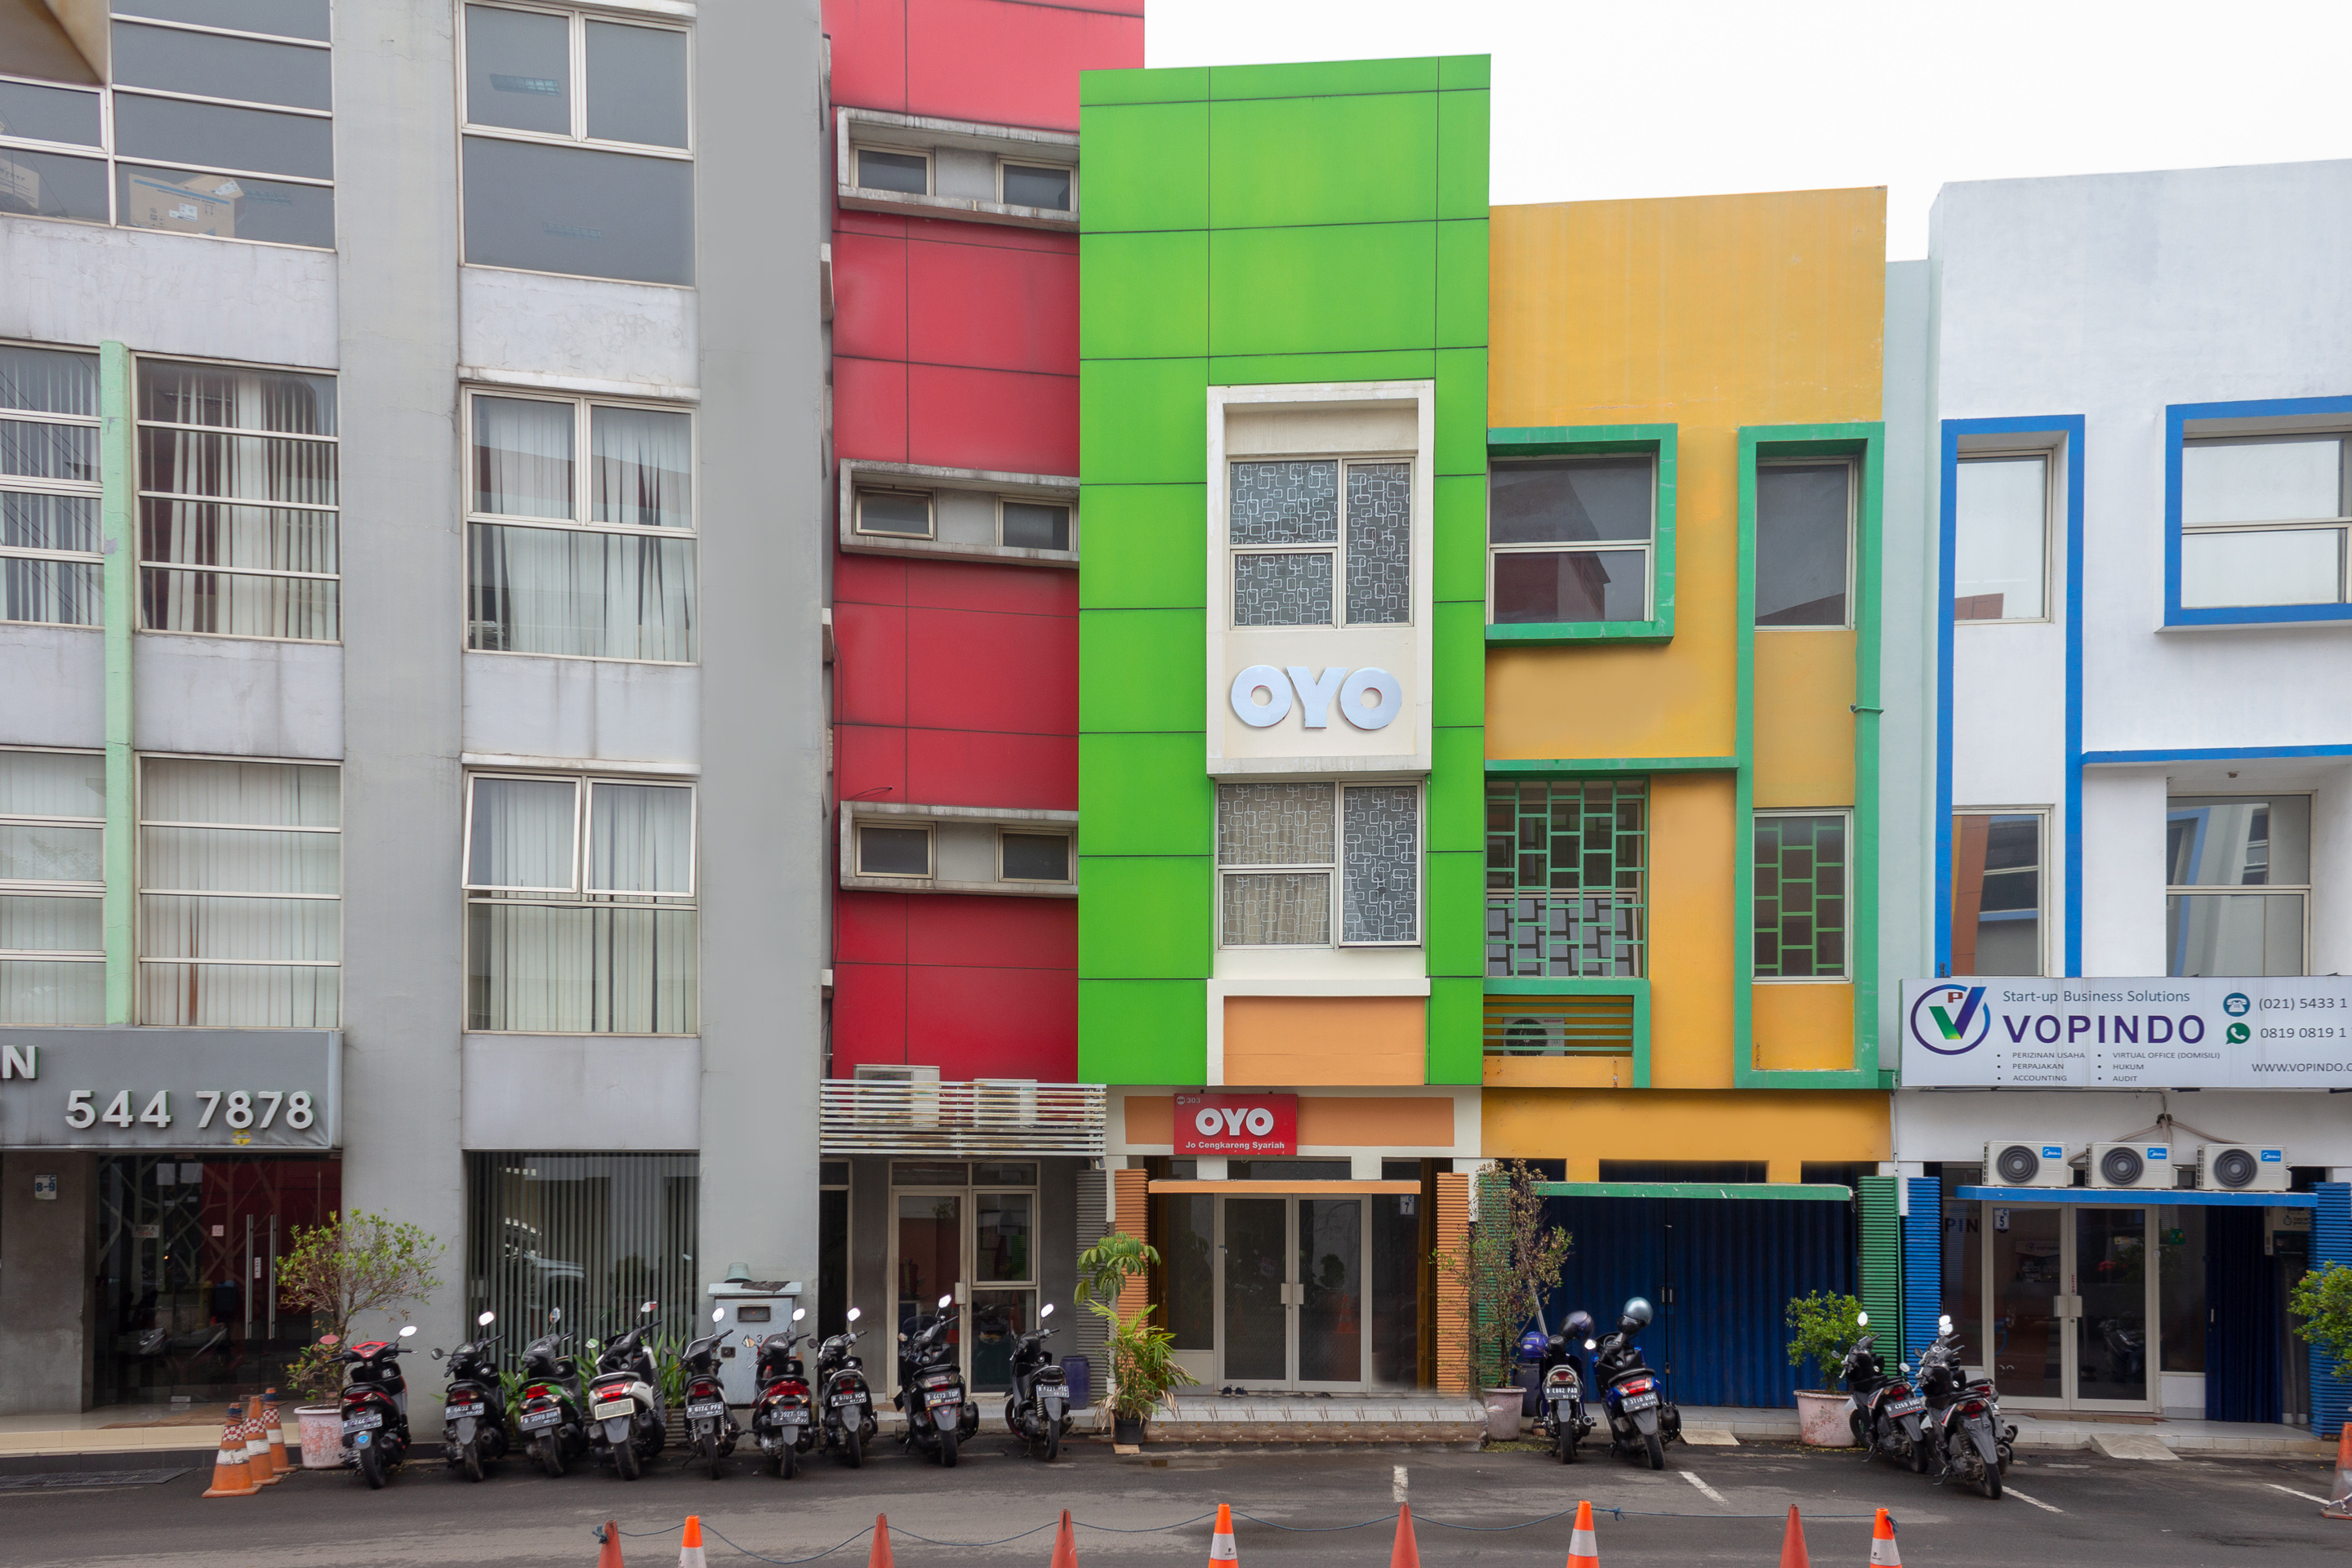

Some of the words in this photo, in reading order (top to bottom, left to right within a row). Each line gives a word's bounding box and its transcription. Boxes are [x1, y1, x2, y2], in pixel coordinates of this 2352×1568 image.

[1231, 664, 1403, 731] OYO
[2003, 991, 2058, 1004] Start-up
[2064, 990, 2123, 1002] Business
[2127, 990, 2190, 1002] Solutions
[2259, 998, 2295, 1011] (021)
[2299, 998, 2335, 1009] 5433
[2002, 1014, 2205, 1044] VOPINDO
[2260, 1028, 2295, 1038] 0819
[2299, 1027, 2334, 1038] 0819
[2177, 1051, 2221, 1060] (DOMISILI)
[65, 1089, 173, 1129] 544
[196, 1090, 315, 1129] 7878
[1195, 1107, 1274, 1136] OYO
[1198, 1141, 1250, 1150] Cengkareng
[1252, 1141, 1285, 1150] Syariah
[36, 1182, 55, 1192] 8-9
[1405, 1202, 1409, 1213] 7
[2000, 1216, 2004, 1227] 5
